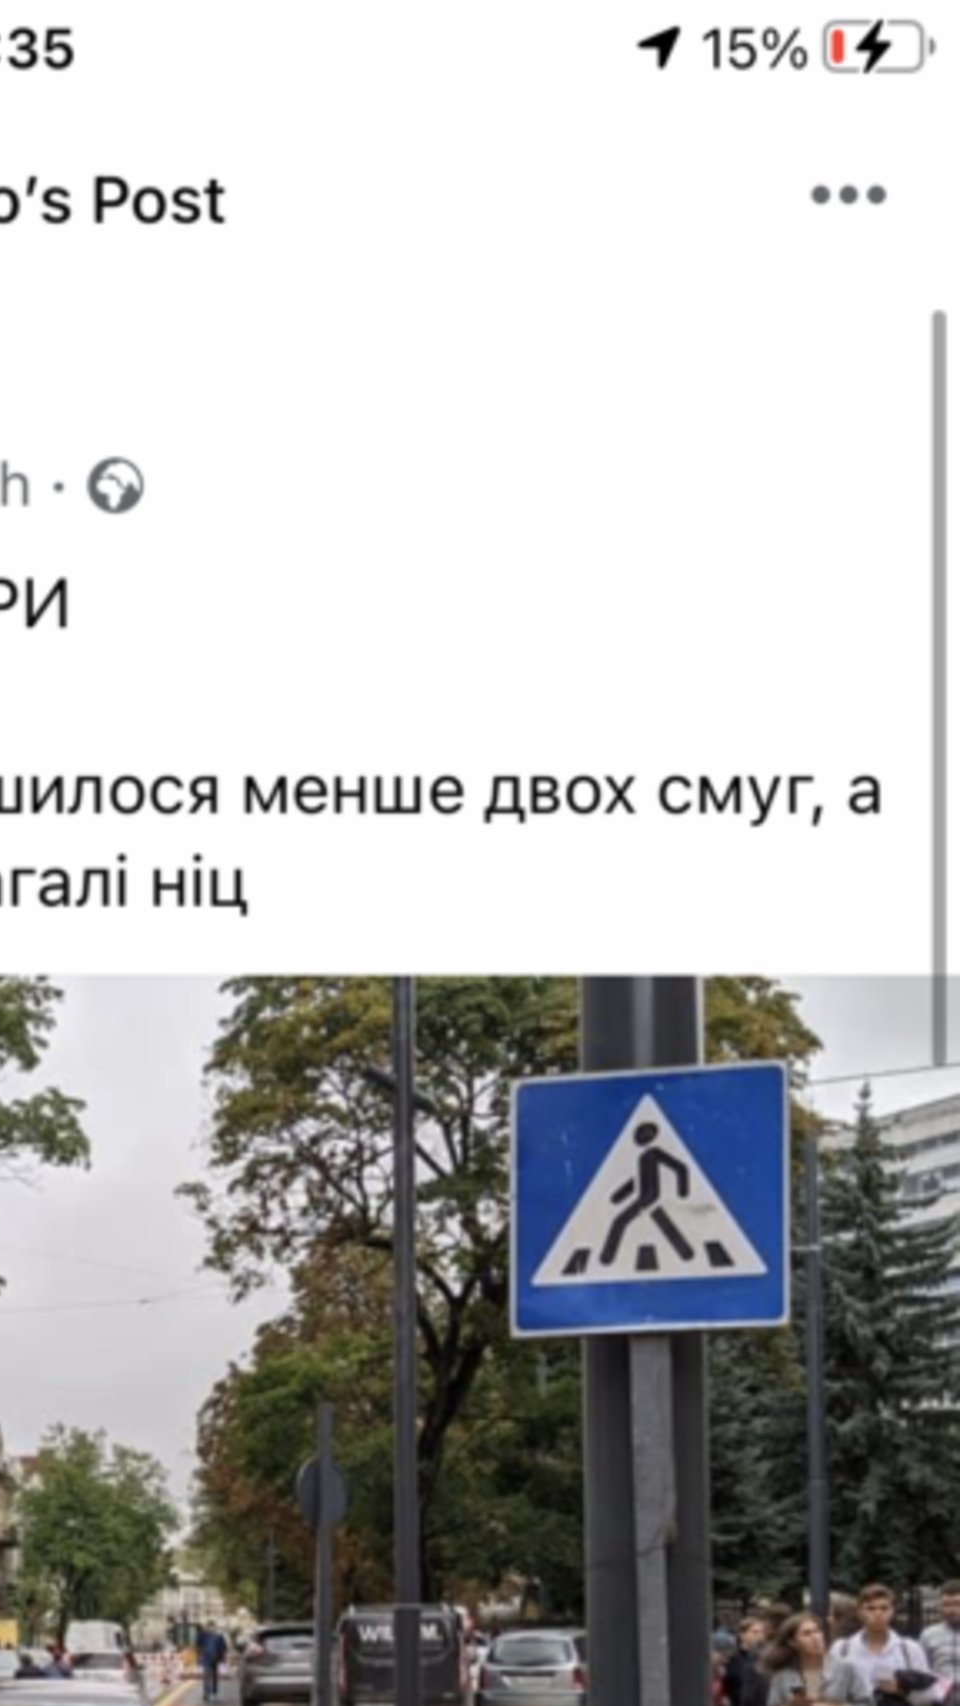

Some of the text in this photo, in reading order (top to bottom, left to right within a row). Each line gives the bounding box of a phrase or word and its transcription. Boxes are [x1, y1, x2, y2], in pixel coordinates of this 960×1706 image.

[701, 26, 809, 72] 15%
[93, 174, 226, 226] Post
[243, 774, 465, 816] менше
[482, 774, 636, 825] двох
[657, 774, 824, 828] смуг,
[847, 774, 882, 816] а
[152, 852, 249, 918] ніц
